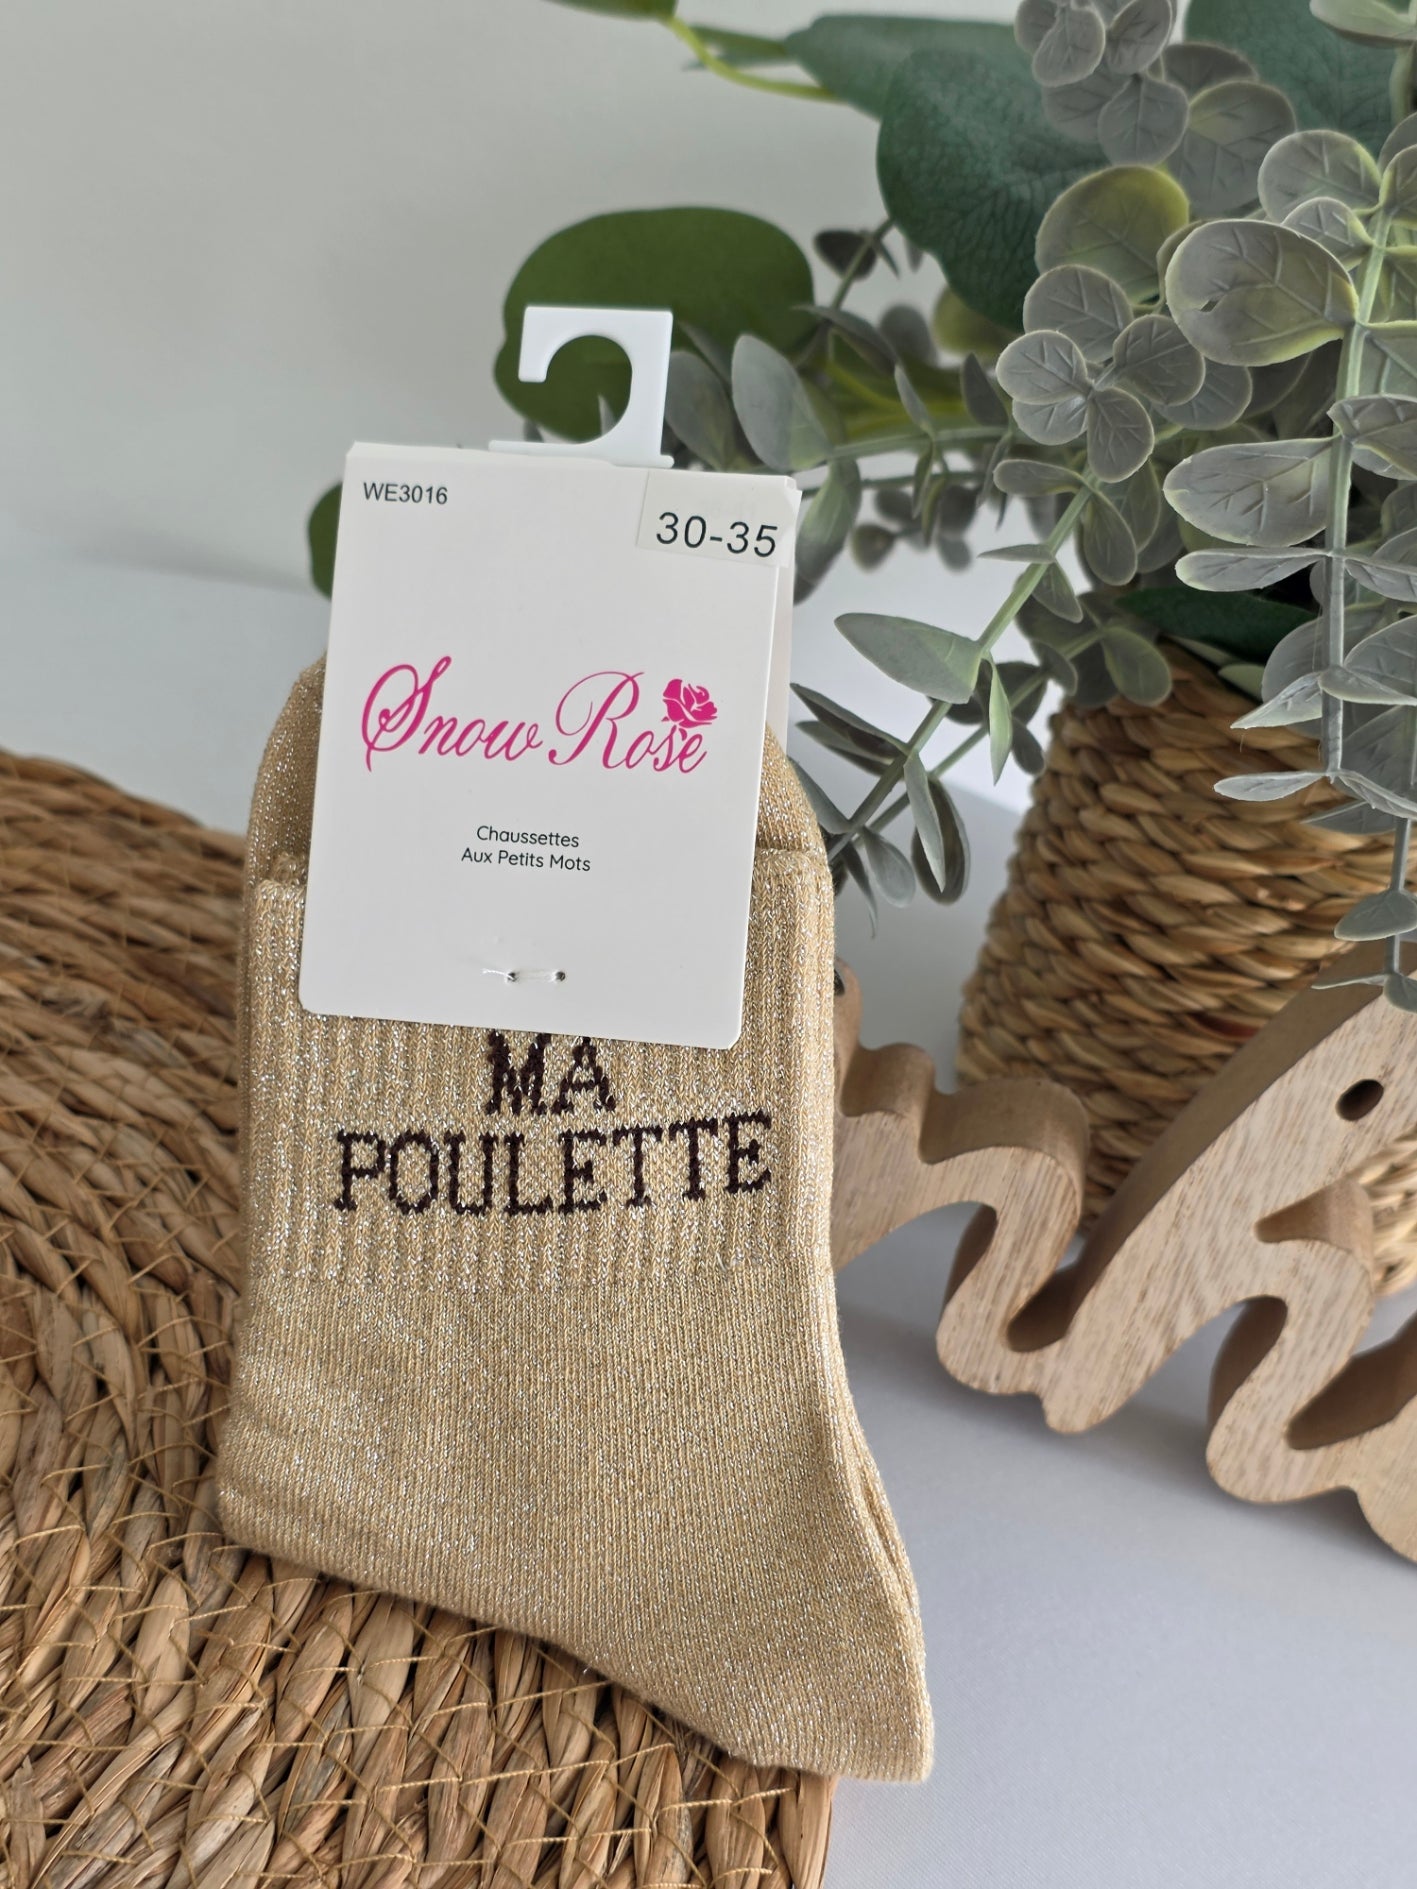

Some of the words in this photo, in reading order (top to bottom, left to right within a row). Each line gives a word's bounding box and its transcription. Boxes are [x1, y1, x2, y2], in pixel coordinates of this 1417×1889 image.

[363, 482, 448, 505] WE3016
[655, 511, 779, 558] 30-35
[360, 655, 544, 772] Snow
[547, 670, 708, 774] Rose
[460, 847, 493, 864] Aux
[497, 849, 545, 868] Petits
[549, 853, 592, 872] Mots
[476, 825, 580, 848] Chaussettes
[484, 1029, 617, 1117] MA
[333, 1109, 772, 1218] POULETTE
